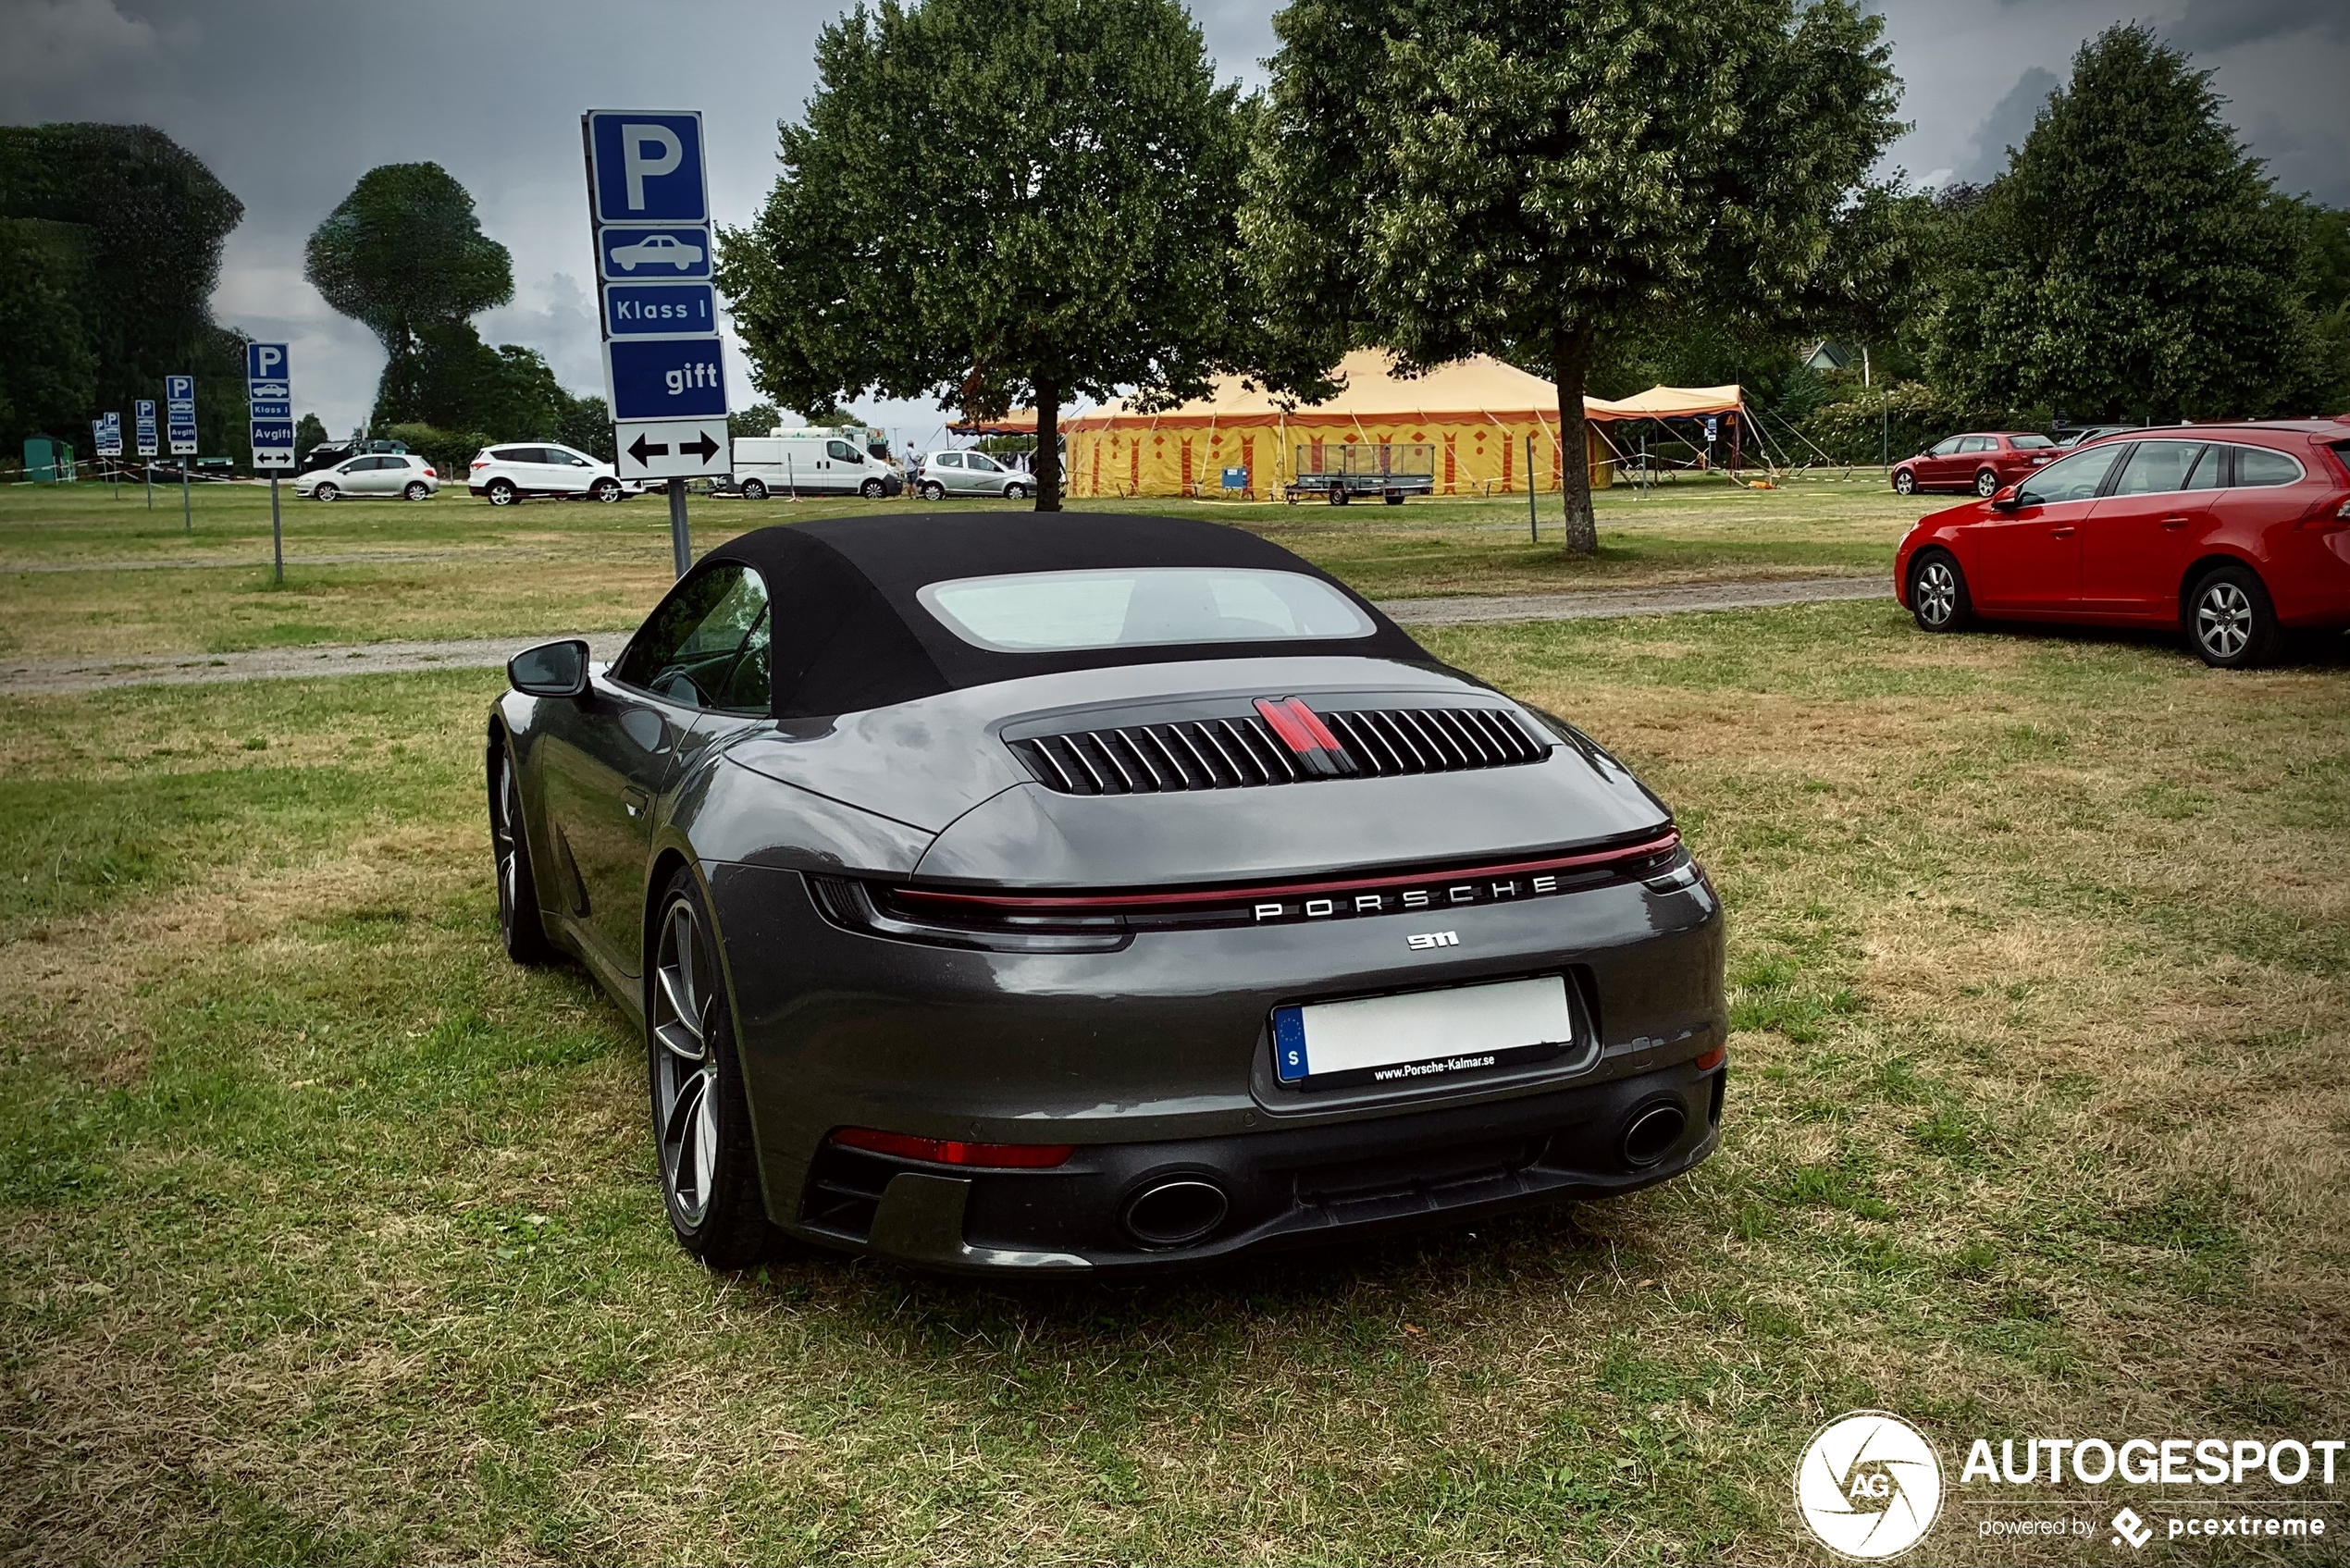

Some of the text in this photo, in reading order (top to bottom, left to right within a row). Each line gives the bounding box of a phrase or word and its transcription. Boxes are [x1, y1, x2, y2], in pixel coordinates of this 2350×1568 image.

[621, 123, 684, 211] P
[616, 301, 688, 320] Klass
[259, 346, 282, 377] P
[173, 378, 189, 398] P
[665, 362, 718, 395] gift
[141, 401, 152, 416] P
[254, 405, 281, 414] Klass
[107, 414, 118, 426] P
[171, 428, 195, 438] Avgift
[254, 427, 291, 441] Avgift
[1255, 875, 1558, 921] PORSCHE
[1406, 930, 1460, 952] 911
[1288, 1050, 1300, 1067] S
[1374, 1056, 1495, 1080] www.Porsche-Kalmar.se
